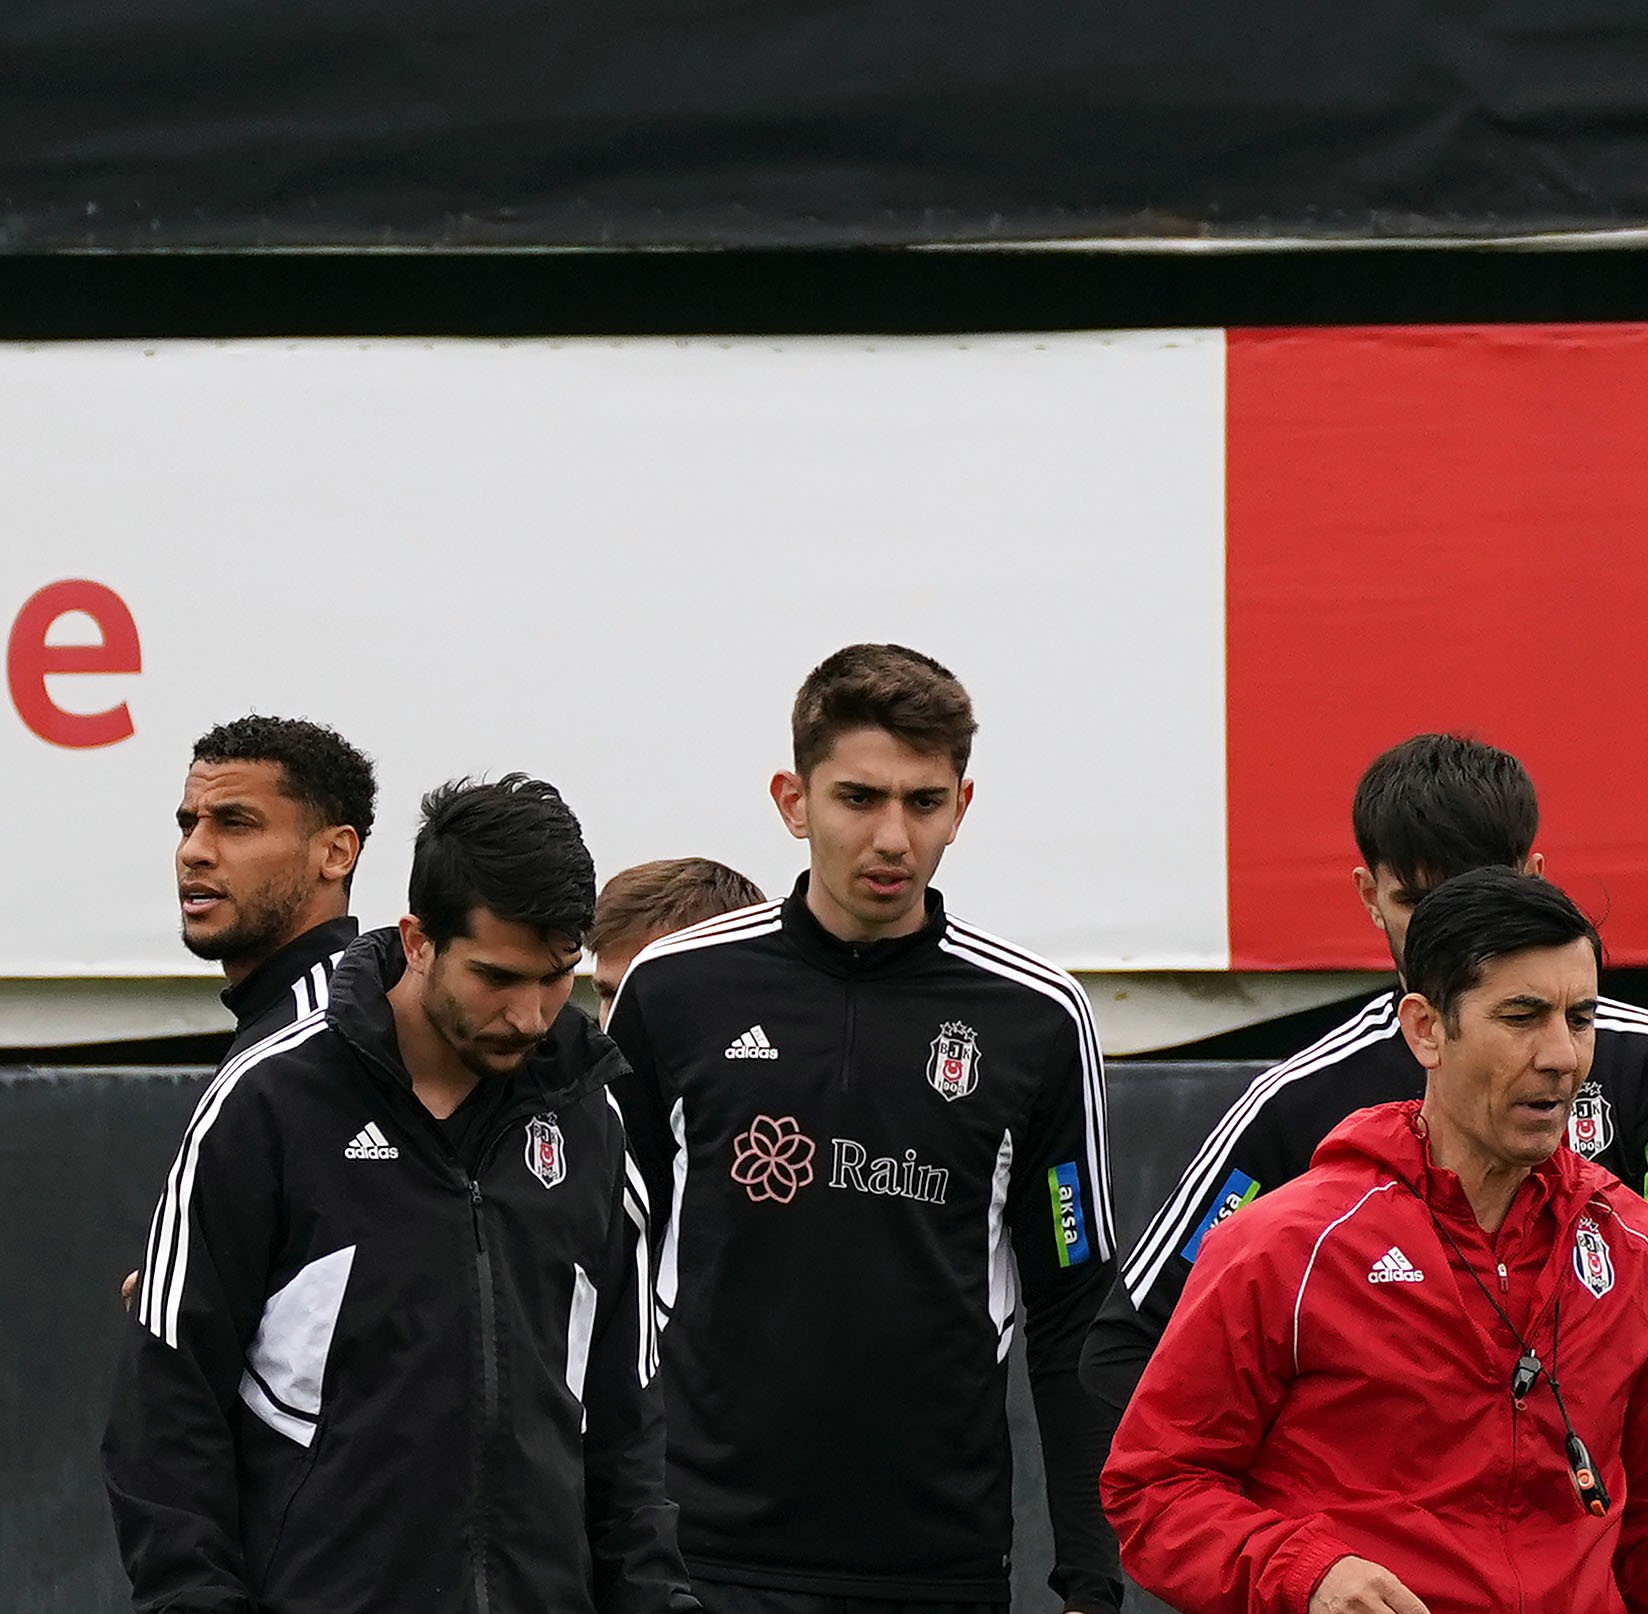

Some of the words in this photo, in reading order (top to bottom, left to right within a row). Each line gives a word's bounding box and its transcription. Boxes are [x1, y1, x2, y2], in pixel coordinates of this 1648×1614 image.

[724, 1045, 779, 1060] adidas
[344, 1144, 400, 1160] adidas
[828, 1138, 949, 1205] Rain
[1057, 1184, 1078, 1246] aksa
[1367, 1268, 1425, 1284] adidas
